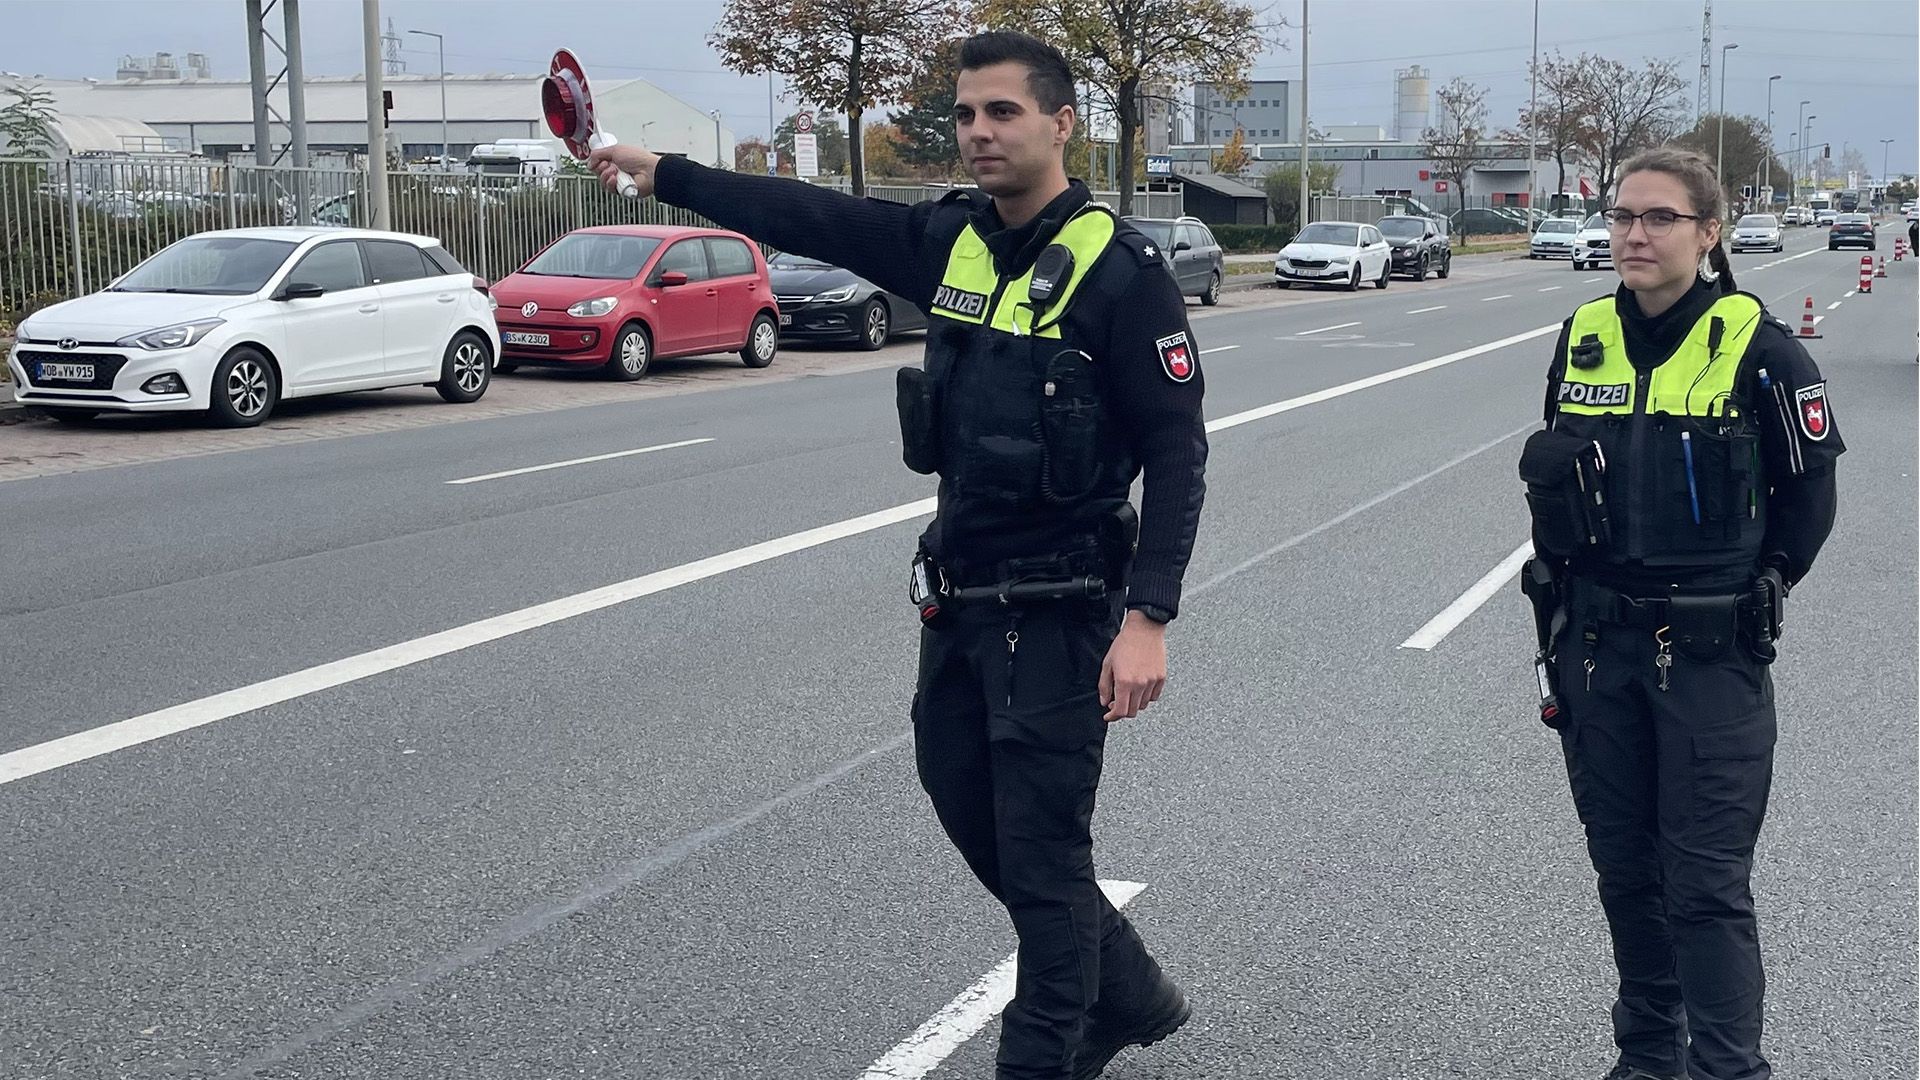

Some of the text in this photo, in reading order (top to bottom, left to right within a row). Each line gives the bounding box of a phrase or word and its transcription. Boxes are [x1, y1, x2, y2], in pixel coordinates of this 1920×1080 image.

[800, 117, 809, 127] 20
[932, 285, 983, 315] POLIZEI
[507, 333, 548, 344] BS K 2302
[1158, 335, 1186, 350] POLIZEI
[41, 364, 93, 378] WOB YW 915
[1557, 382, 1627, 405] POLIZEI
[1798, 387, 1823, 402] POLIZEI
